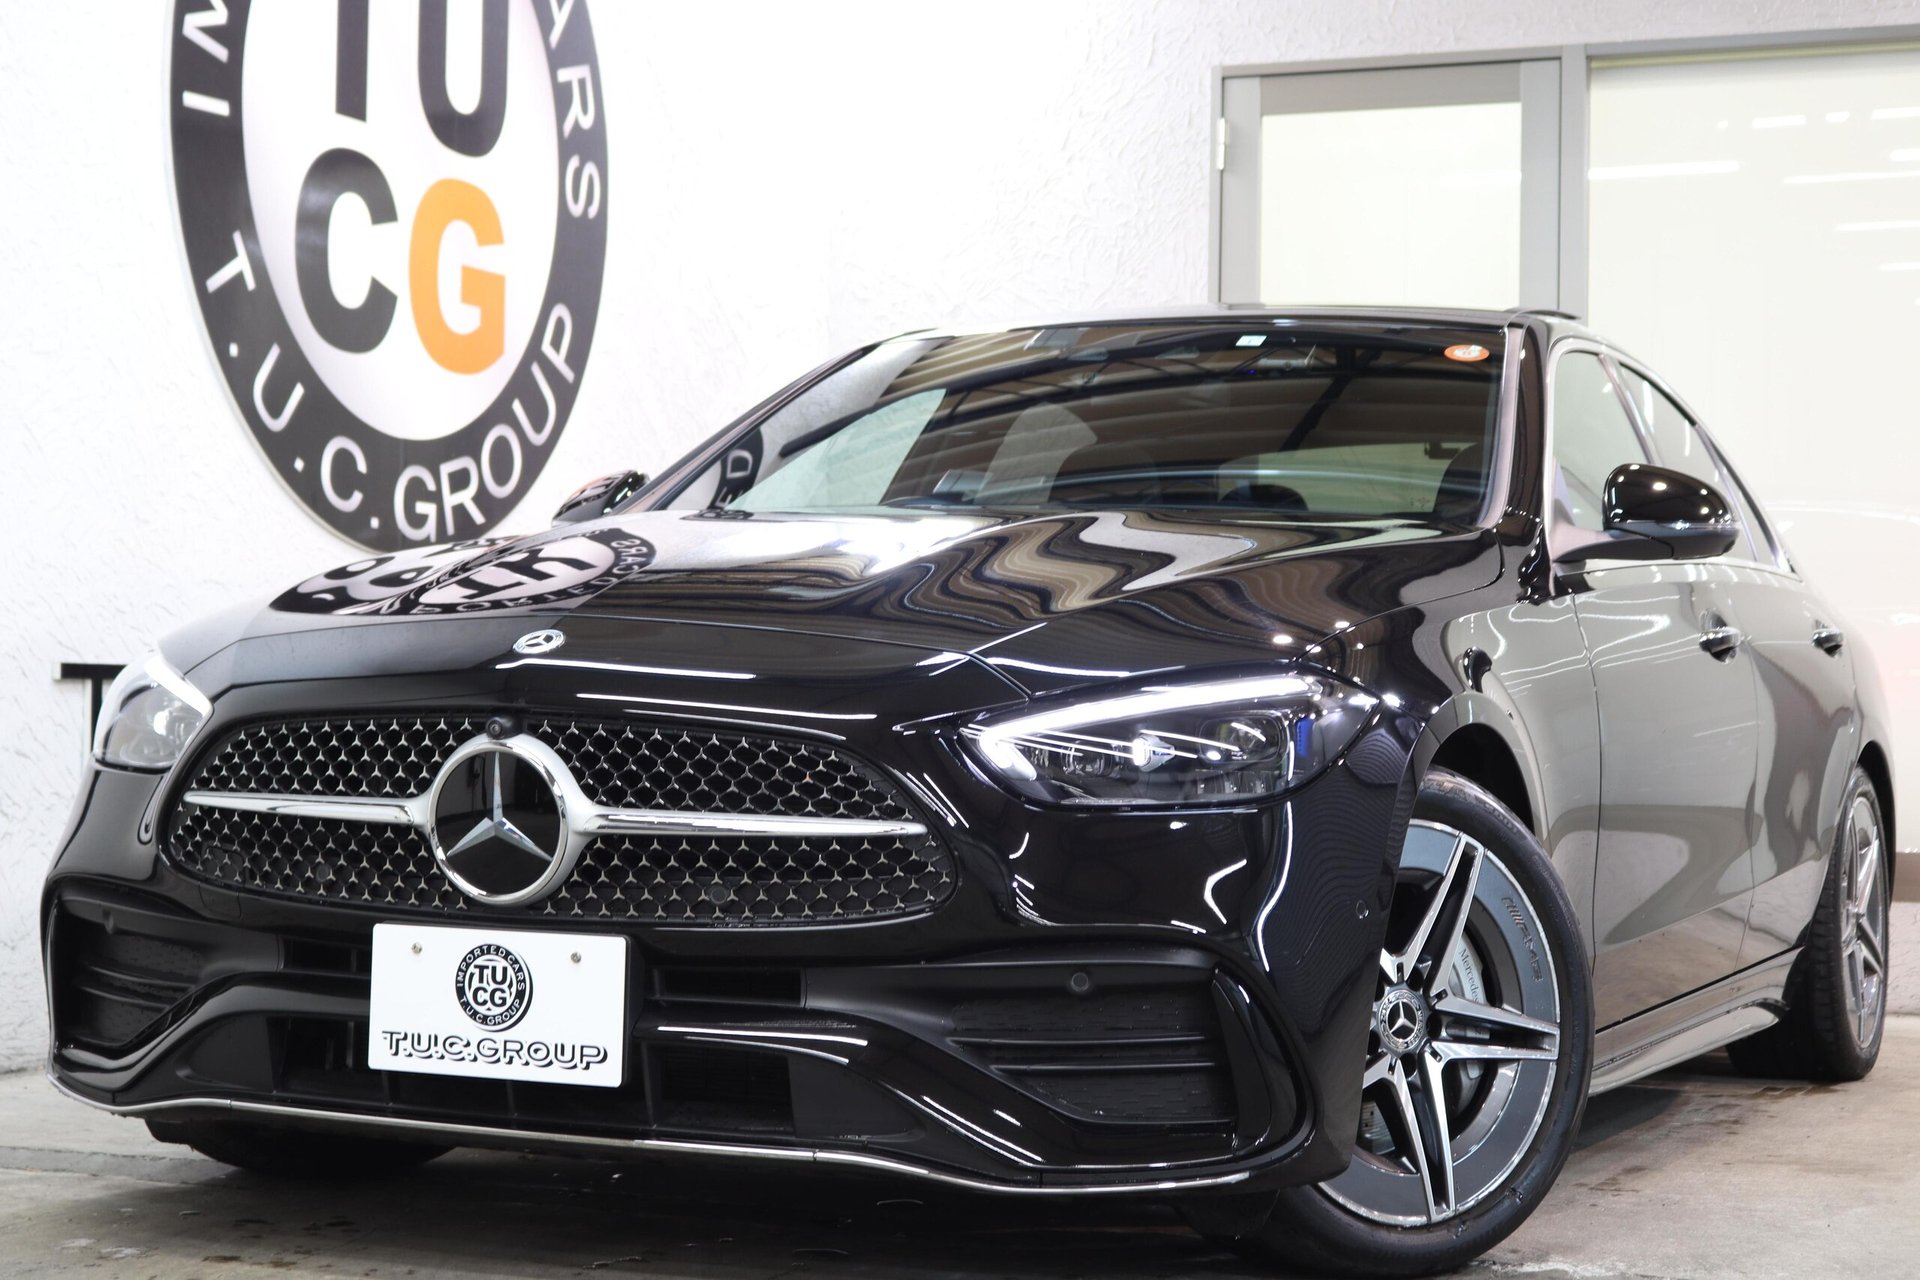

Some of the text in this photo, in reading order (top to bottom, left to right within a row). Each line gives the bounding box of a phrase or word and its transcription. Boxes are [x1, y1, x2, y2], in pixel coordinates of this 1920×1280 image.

[295, 147, 506, 376] CG
[456, 945, 525, 991] IMPORTED CARS
[473, 964, 508, 986] TU
[472, 986, 508, 1008] CG
